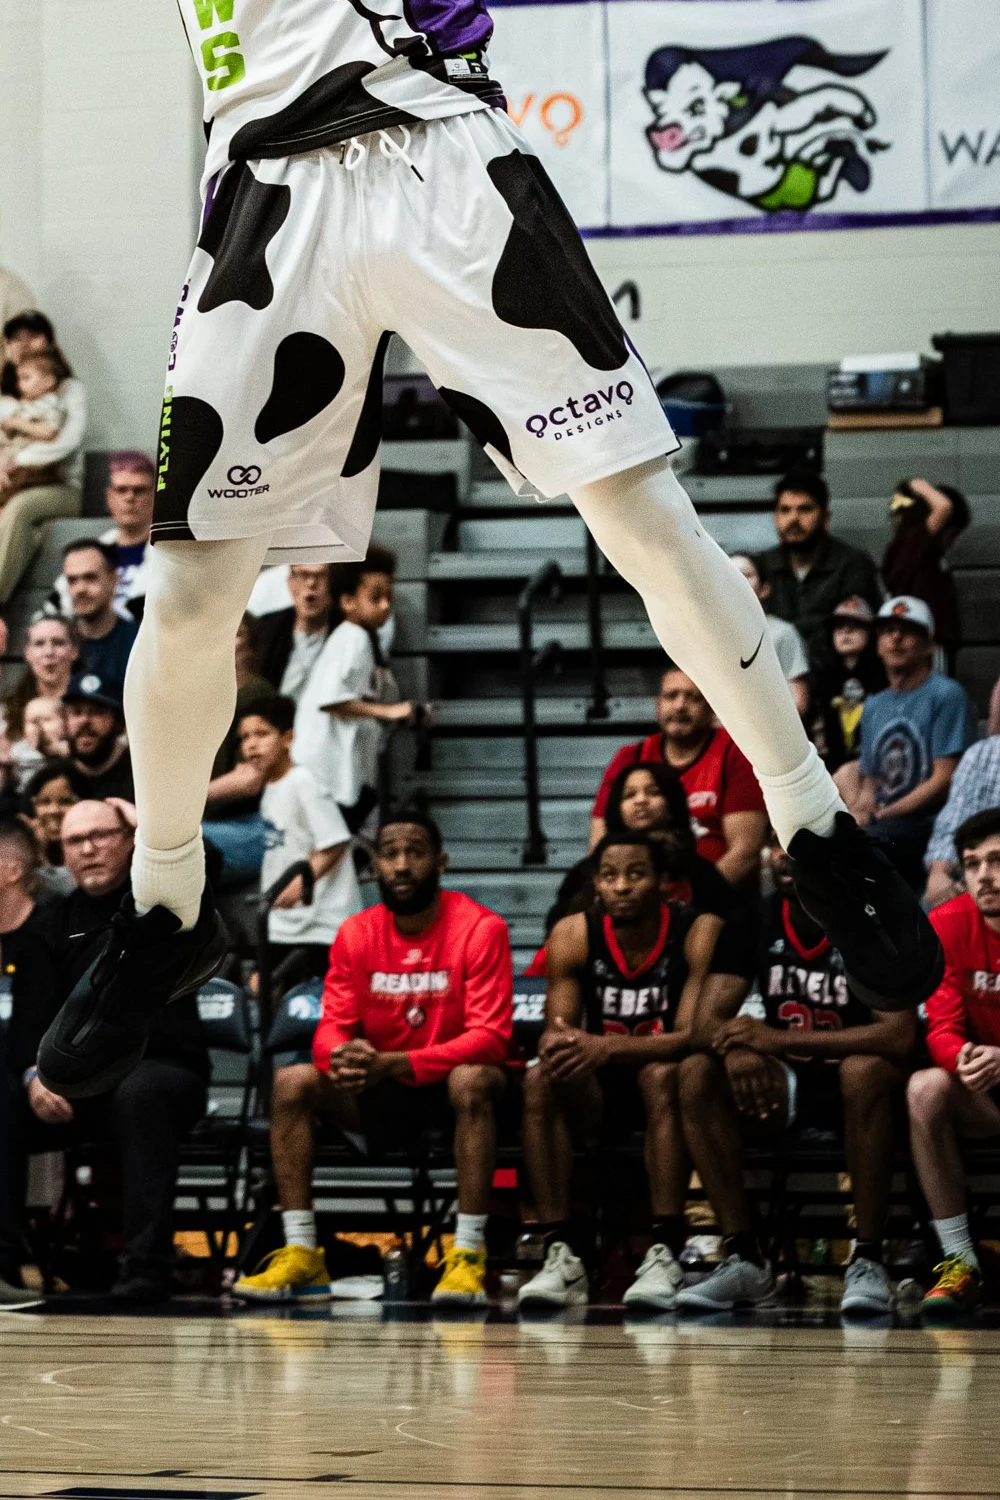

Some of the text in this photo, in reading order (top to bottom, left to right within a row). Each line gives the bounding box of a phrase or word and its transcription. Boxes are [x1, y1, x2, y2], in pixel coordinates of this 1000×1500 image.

[525, 380, 635, 439] octavo
[554, 409, 623, 441] DESIGNS
[207, 484, 270, 499] WOOTER
